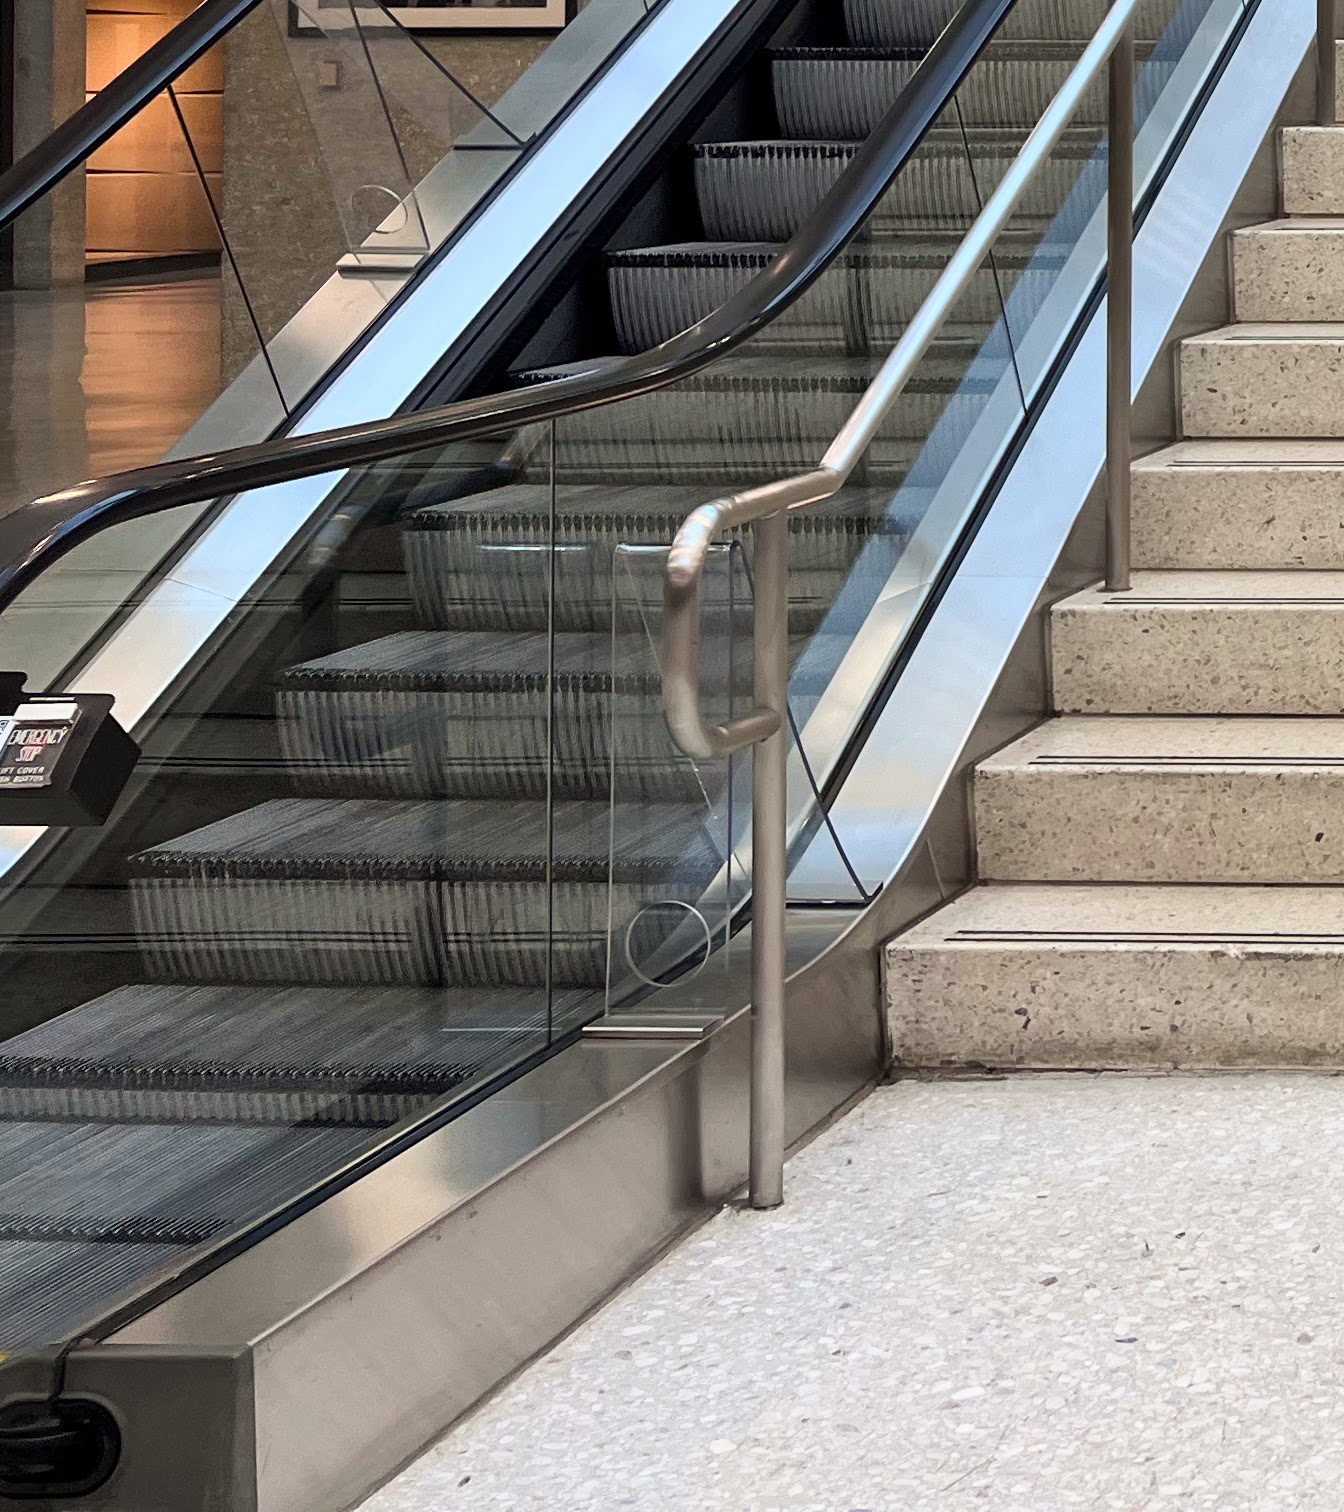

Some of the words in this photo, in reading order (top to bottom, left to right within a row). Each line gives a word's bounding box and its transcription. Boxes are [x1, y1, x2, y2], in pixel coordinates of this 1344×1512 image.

[7, 726, 69, 746] EMERGENCY
[15, 746, 43, 762] STOP
[0, 766, 15, 775] IFT
